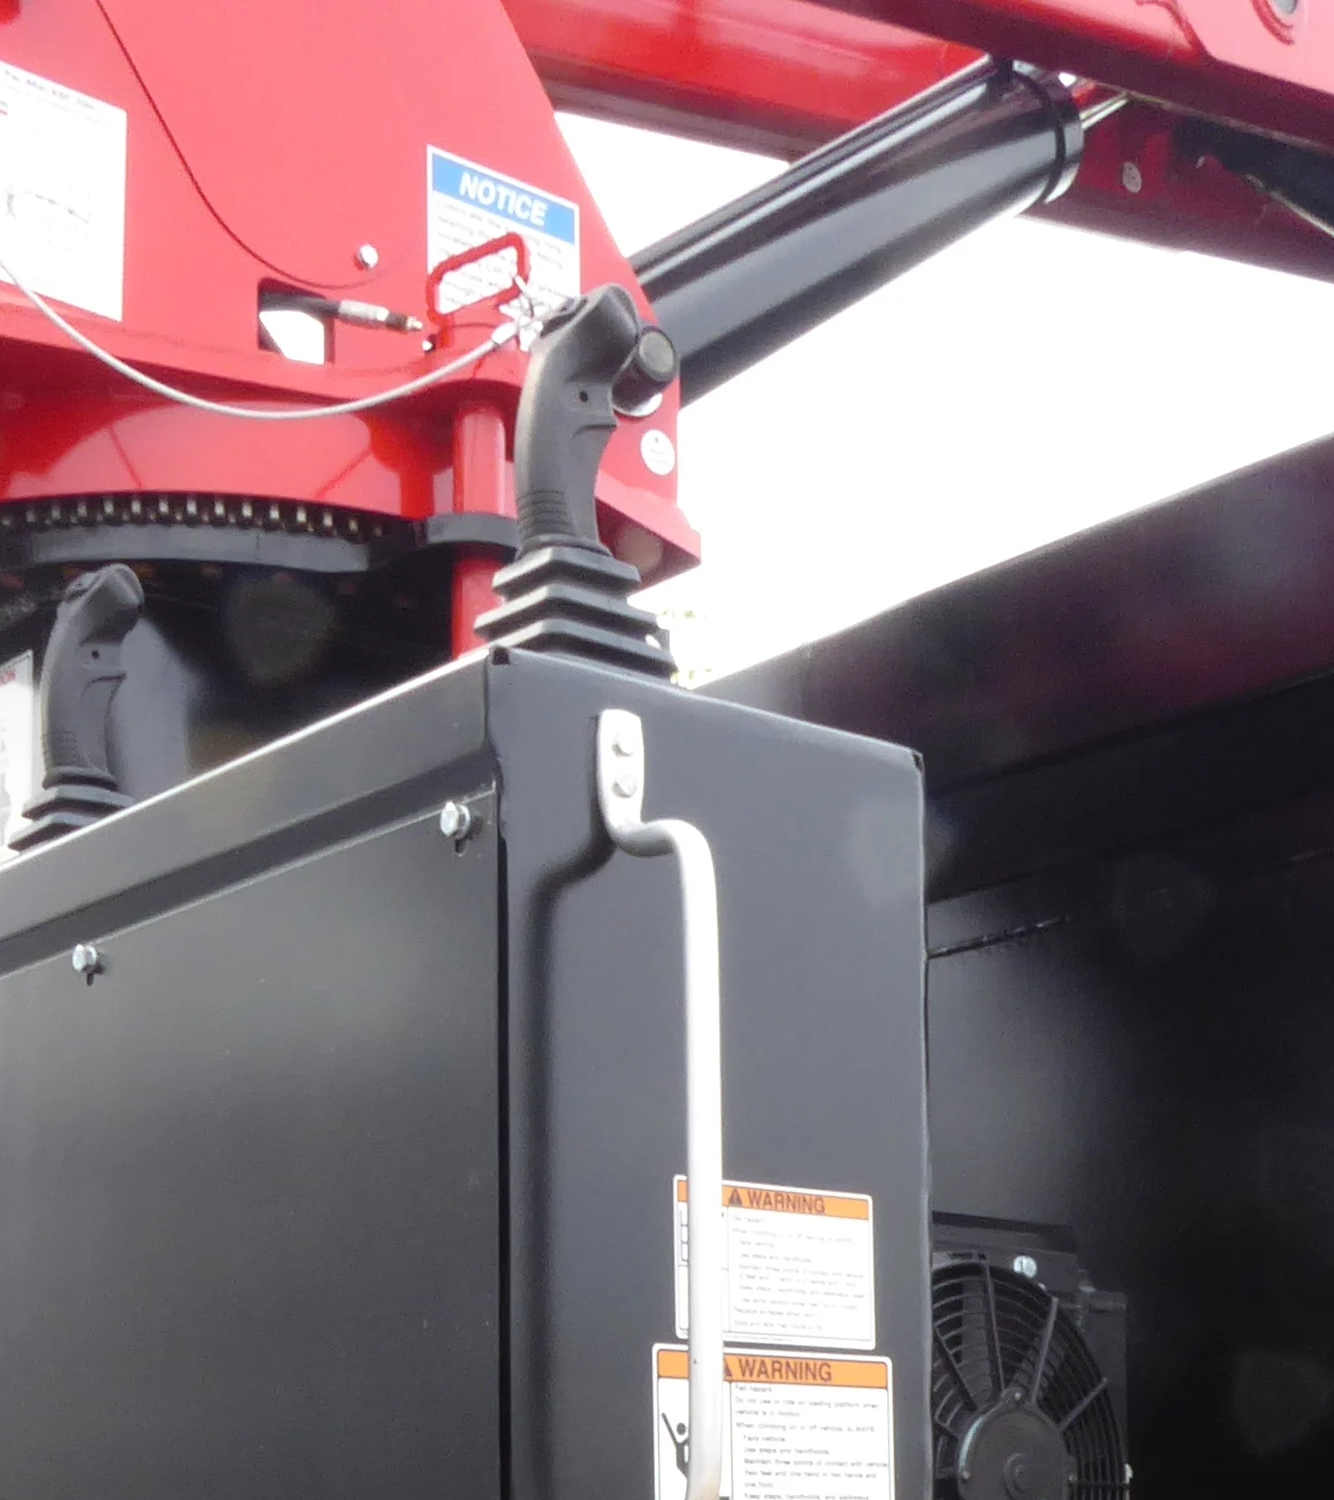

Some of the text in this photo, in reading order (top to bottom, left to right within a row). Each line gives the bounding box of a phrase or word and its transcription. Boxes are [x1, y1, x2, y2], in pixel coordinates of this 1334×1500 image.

[459, 171, 547, 227] NOTICE
[747, 1189, 825, 1213] WARNING
[739, 1358, 832, 1382] WARNING
